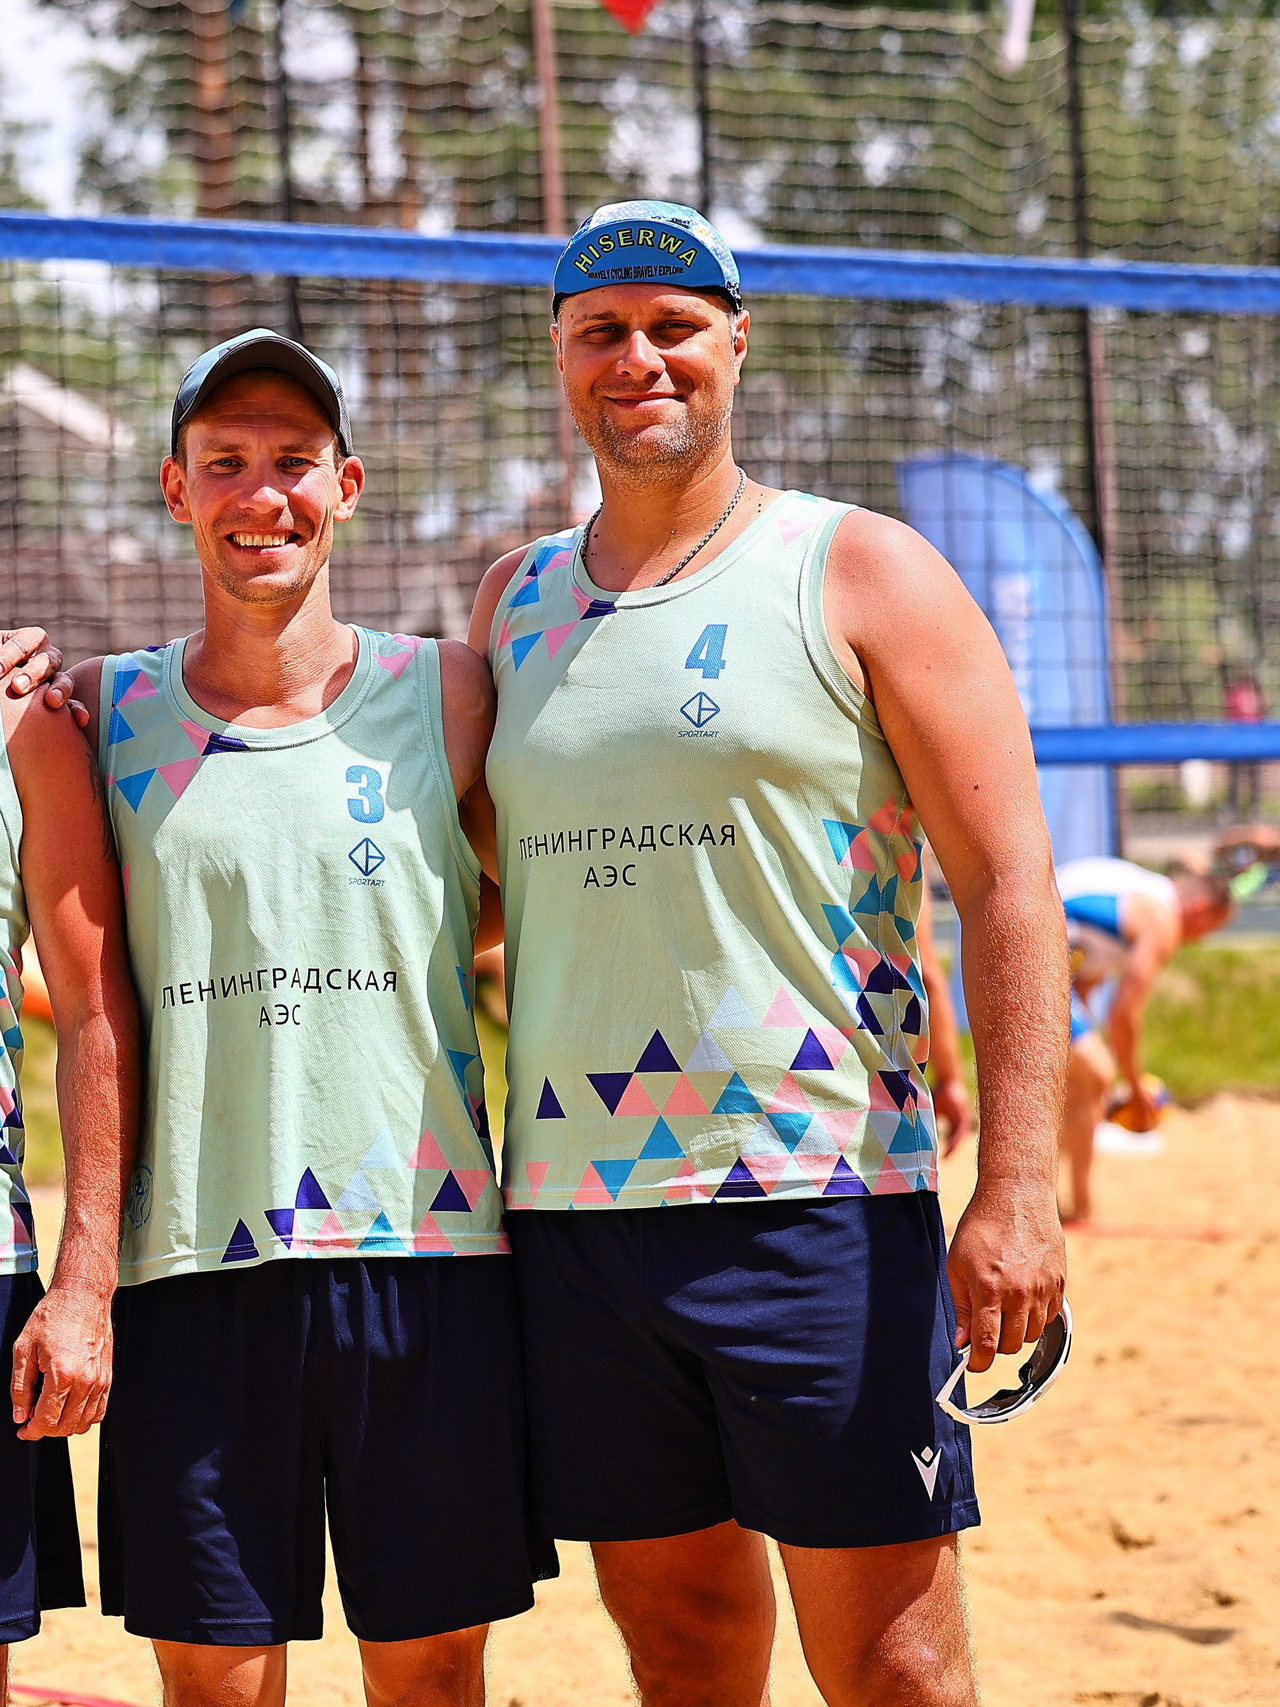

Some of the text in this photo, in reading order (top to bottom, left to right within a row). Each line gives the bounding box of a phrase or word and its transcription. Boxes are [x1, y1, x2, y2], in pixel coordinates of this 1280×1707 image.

[573, 227, 698, 275] HISERWA
[610, 266, 633, 280] CYCLING
[633, 265, 658, 279] BRAVELY
[684, 623, 728, 679] 4
[677, 729, 719, 739] SPORTART
[345, 765, 386, 824] 3
[519, 823, 737, 861] ЛЕНИНГРАДСКАЯ
[348, 877, 386, 888] SPORTART
[583, 864, 637, 889] АЭС
[161, 967, 399, 1011] ЛЕНИНГРАДСКАЯ
[258, 1004, 302, 1029] АЭС
